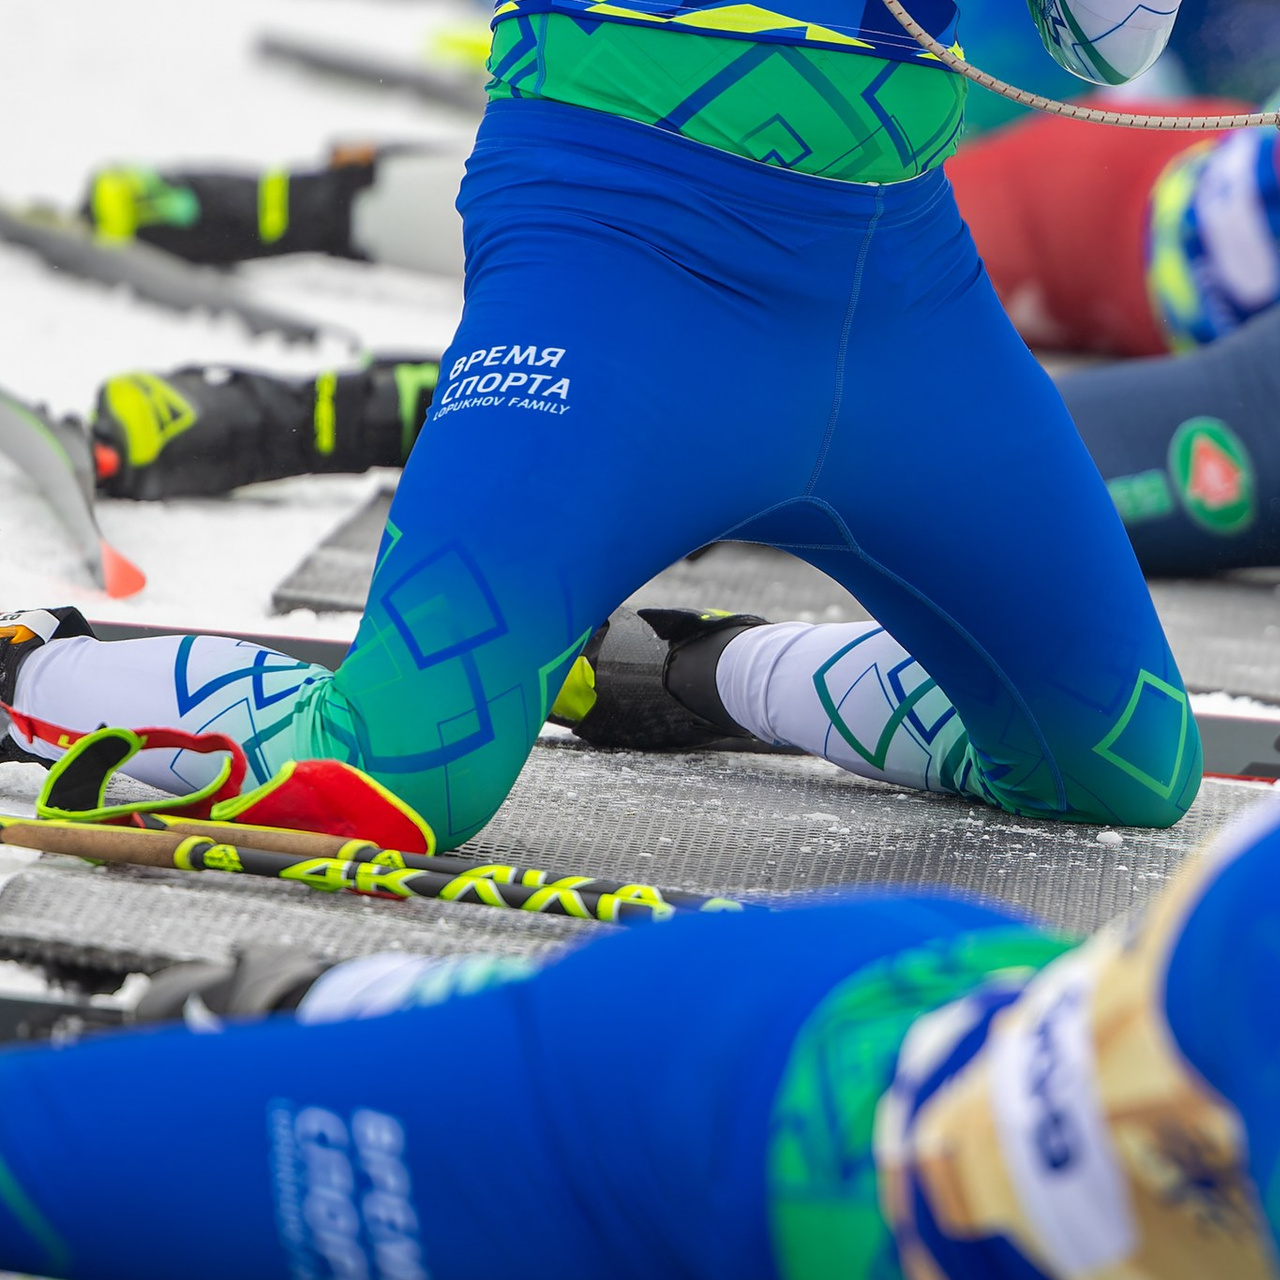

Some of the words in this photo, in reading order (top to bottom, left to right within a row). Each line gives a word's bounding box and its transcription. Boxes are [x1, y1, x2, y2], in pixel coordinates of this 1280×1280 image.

[449, 345, 566, 381] ВРЕМЯ
[440, 372, 571, 406] СПОРТА
[432, 396, 505, 421] LOPUKHOV
[507, 397, 571, 416] FAMILY
